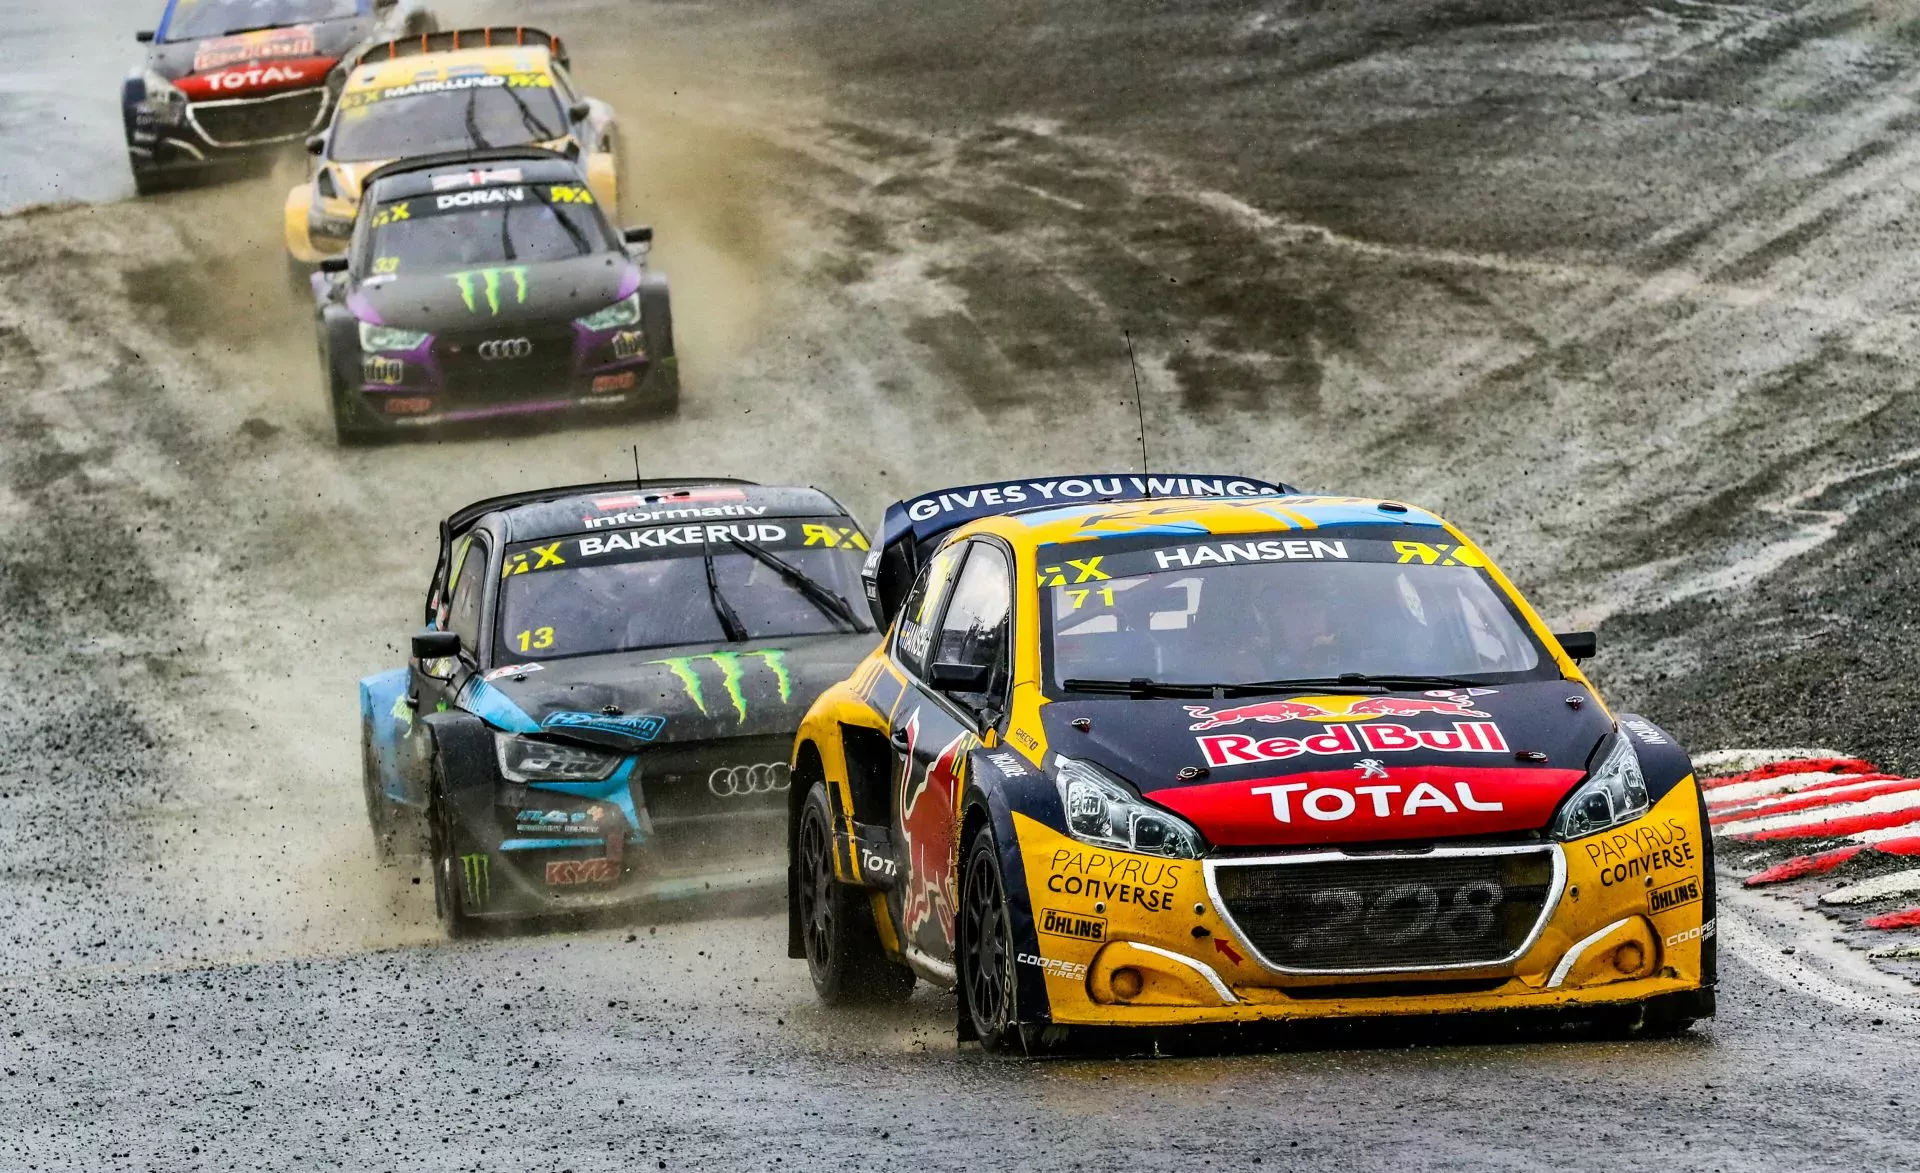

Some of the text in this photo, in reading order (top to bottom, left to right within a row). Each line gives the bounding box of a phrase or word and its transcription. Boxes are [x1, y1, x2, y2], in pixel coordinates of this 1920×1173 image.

[204, 67, 304, 91] TOTAL
[384, 75, 505, 98] MARKLUND
[436, 187, 524, 209] DORAN
[908, 484, 1028, 522] GIVES
[1031, 478, 1122, 500] YOU
[582, 505, 767, 529] informativ
[579, 524, 787, 557] BAKKERUD
[1154, 540, 1348, 570] HANSEN
[1064, 587, 1115, 609] 71
[516, 626, 555, 652] 13
[1197, 721, 1510, 767] Red Bull
[1251, 782, 1504, 824] TOTAL
[1585, 818, 1686, 867] PAPYRUS
[1051, 849, 1182, 889] PAPYRUS
[1600, 842, 1695, 887] CONVERSE
[1048, 874, 1174, 912] CONVERSE
[1651, 882, 1698, 911] ÖHLINS
[1044, 911, 1104, 939] ÖHLINS
[1289, 880, 1504, 950] 208
[1017, 953, 1087, 973] COOPER
[1047, 968, 1085, 981] TIRES
